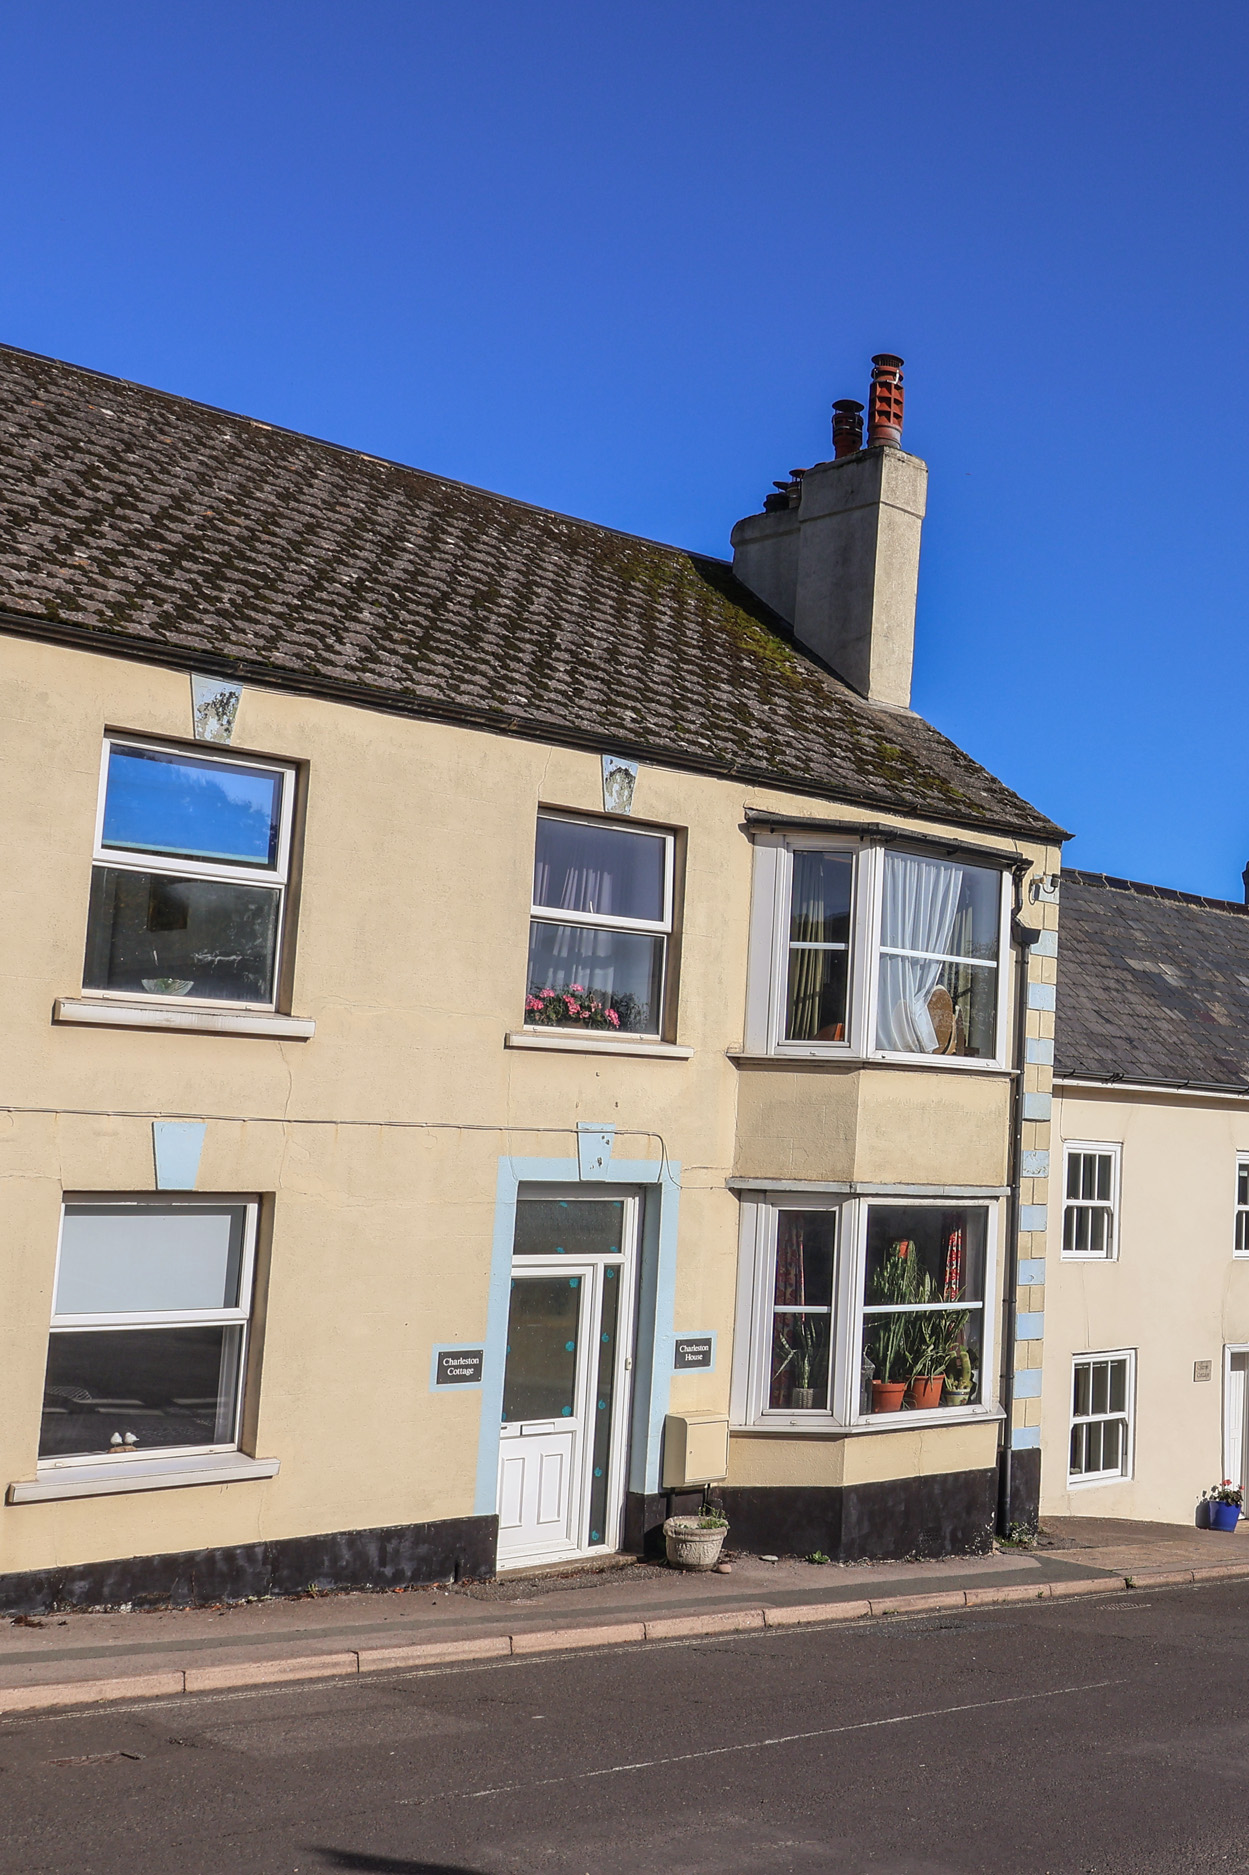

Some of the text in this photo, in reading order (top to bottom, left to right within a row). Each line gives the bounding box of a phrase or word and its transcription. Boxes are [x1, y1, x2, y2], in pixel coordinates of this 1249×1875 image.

[680, 1344, 709, 1353] Charleston
[443, 1356, 479, 1366] Charleston
[685, 1353, 703, 1361] House
[447, 1367, 474, 1376] Cottage
